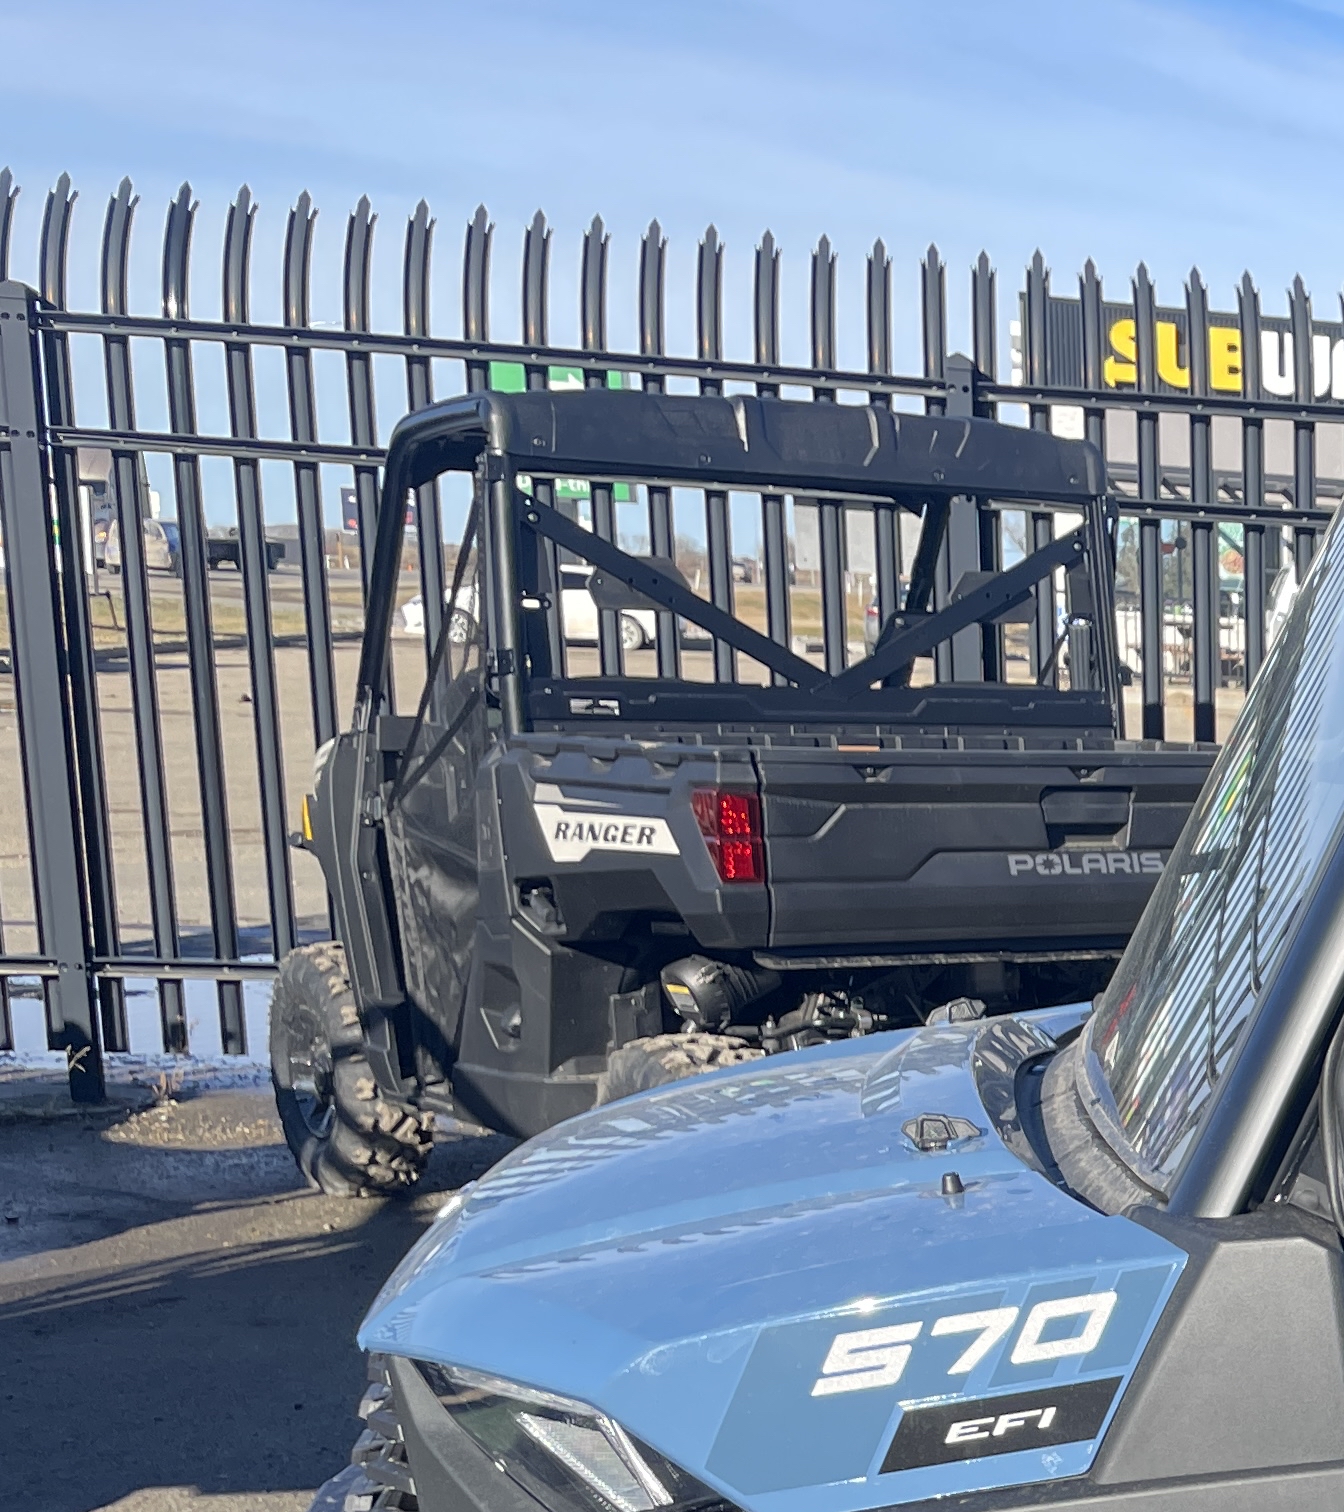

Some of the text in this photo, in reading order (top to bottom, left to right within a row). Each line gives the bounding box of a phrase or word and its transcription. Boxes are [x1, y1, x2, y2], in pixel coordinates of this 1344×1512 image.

[554, 822, 656, 845] RANGER
[1007, 852, 1166, 877] POLARIS
[809, 1291, 1118, 1397] 570
[944, 1406, 1057, 1445] EFI
